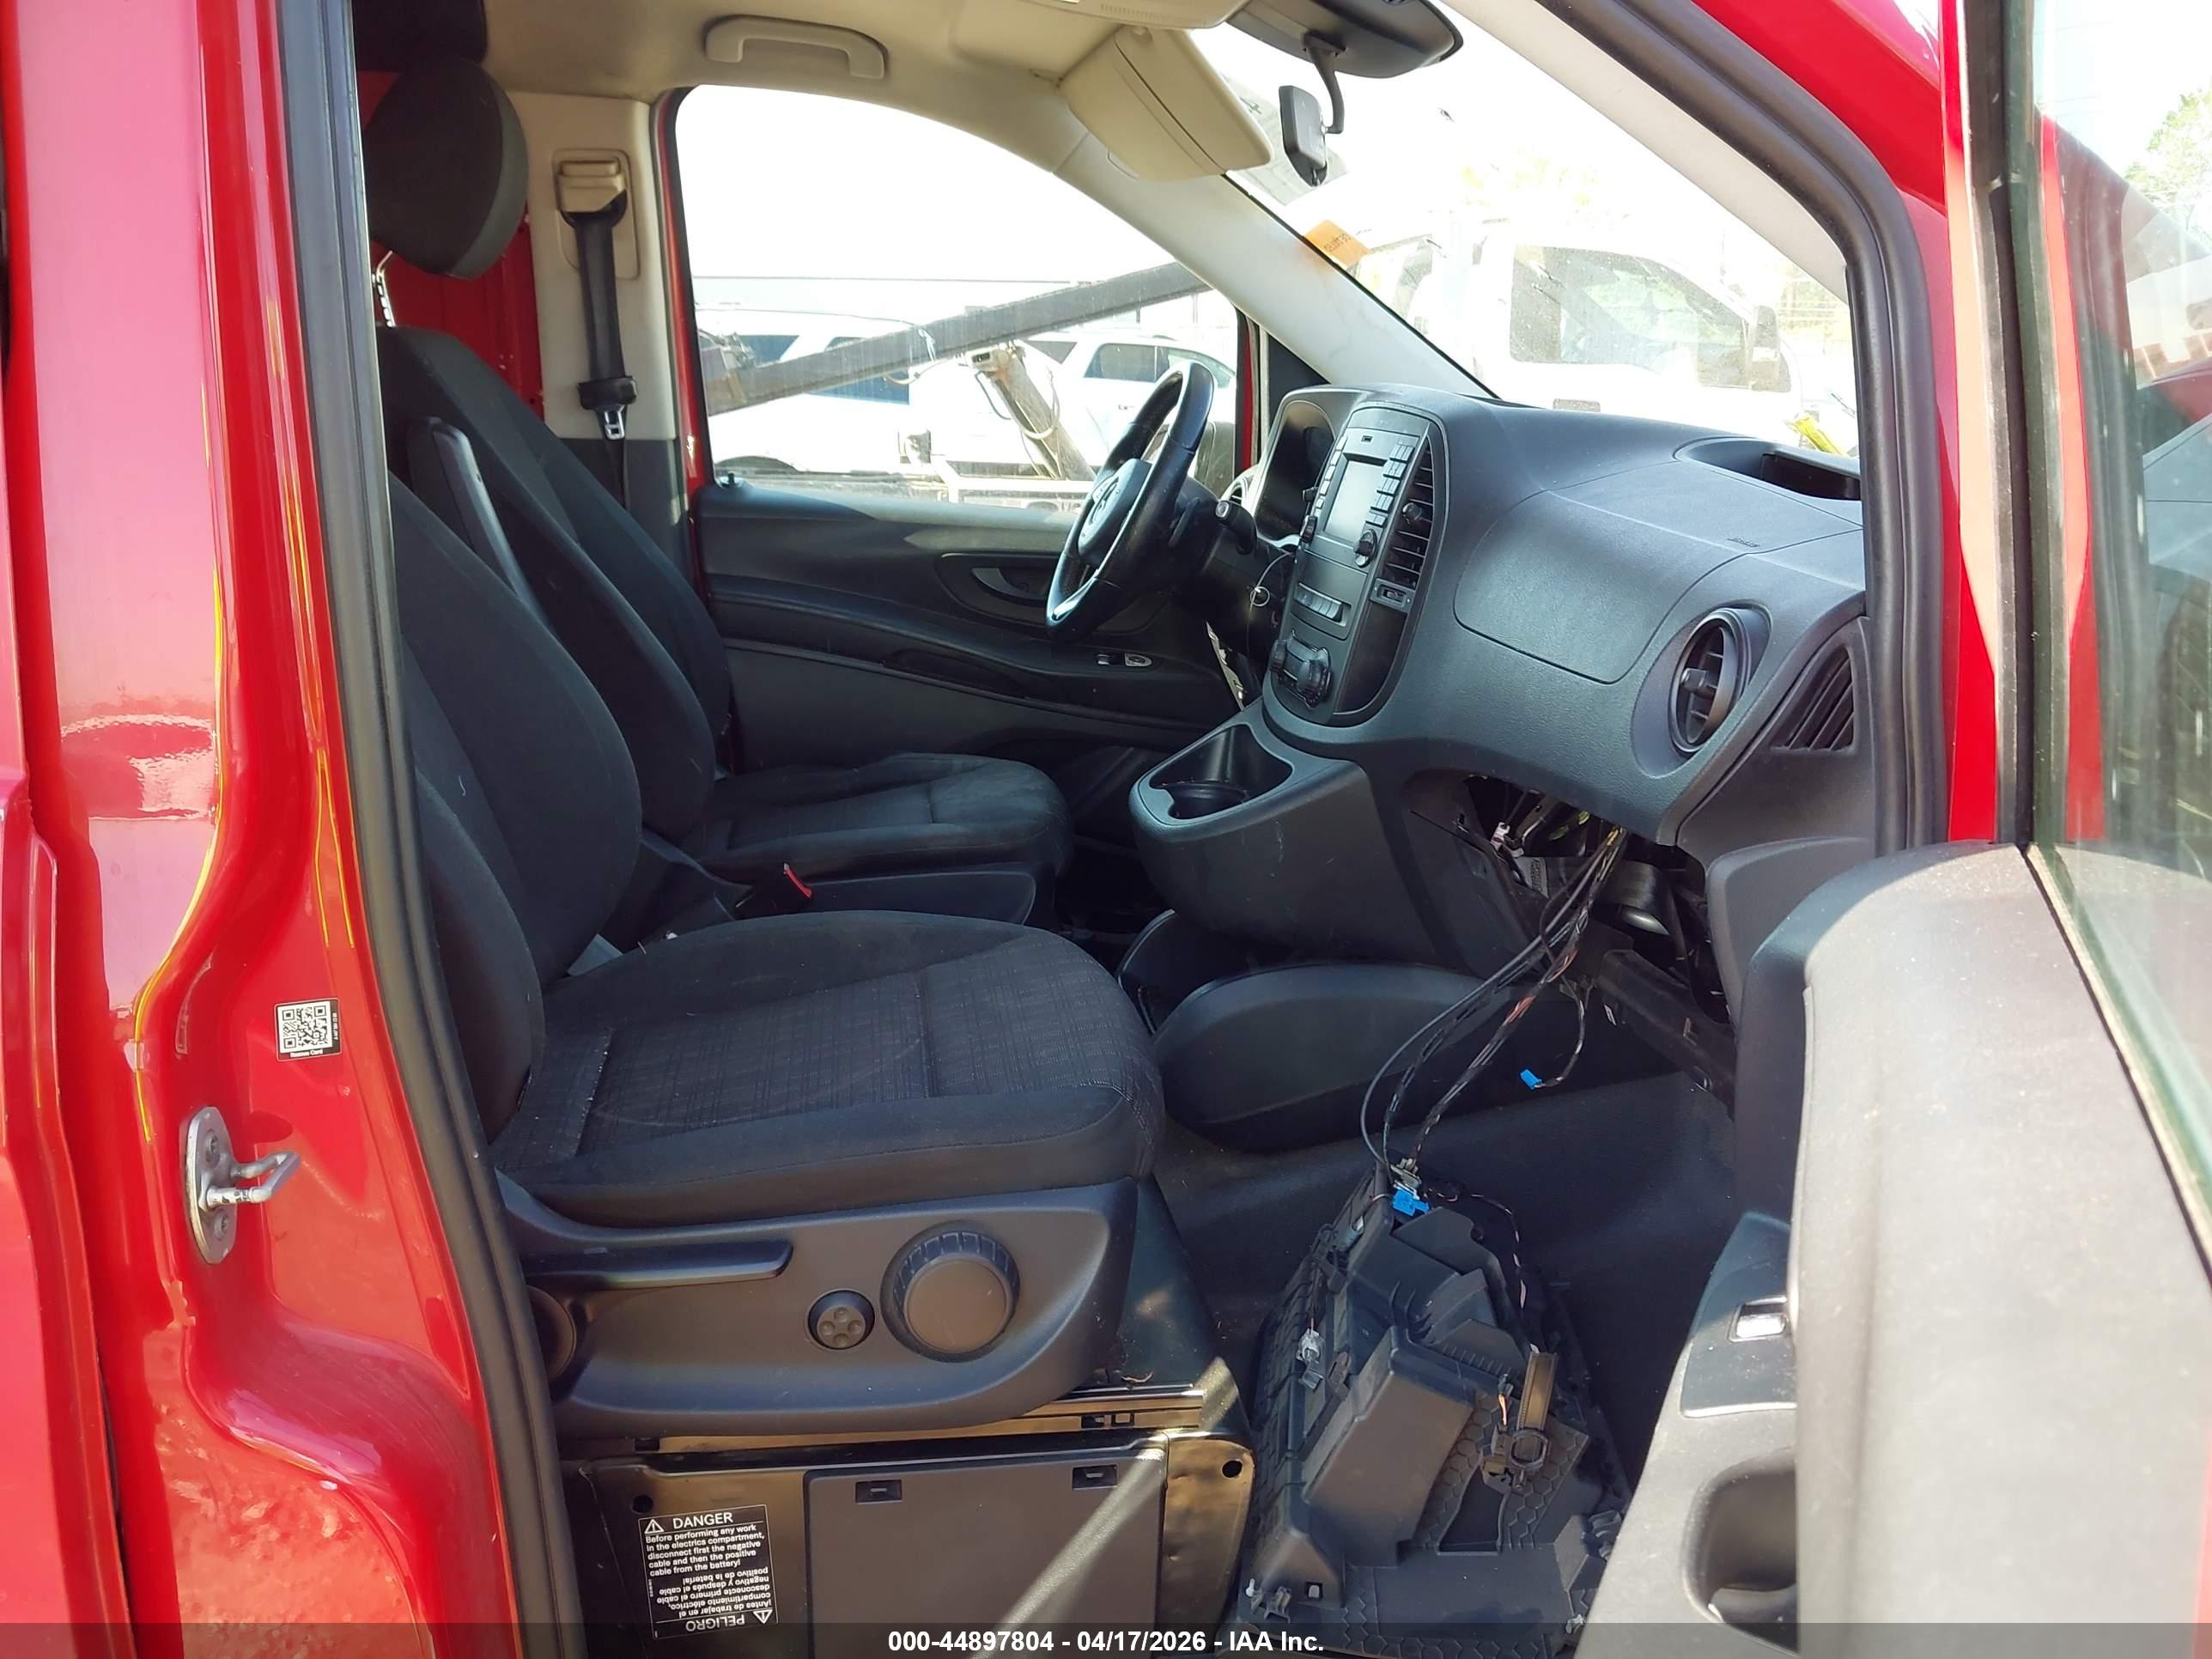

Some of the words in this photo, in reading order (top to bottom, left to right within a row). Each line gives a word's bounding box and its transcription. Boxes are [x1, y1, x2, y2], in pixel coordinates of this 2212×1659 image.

[672, 1512, 733, 1529] DANGER
[645, 1534, 672, 1544] Before
[674, 1529, 719, 1542] performing
[720, 1527, 735, 1535] any
[736, 1524, 757, 1533] work
[672, 1539, 706, 1549] electrics
[708, 1532, 764, 1545] compartment,
[647, 1548, 692, 1560] disconnect
[693, 1546, 710, 1554] first
[726, 1540, 761, 1551] negative
[648, 1559, 671, 1568] cable
[672, 1557, 688, 1565] and
[725, 1549, 757, 1560] positive
[649, 1568, 672, 1577] cable
[709, 1559, 741, 1570] battery!
[736, 1566, 769, 1577] positivo
[692, 1582, 726, 1591] después
[734, 1576, 769, 1586] negativo
[659, 1587, 681, 1595] cable
[690, 1589, 722, 1599] primero
[723, 1584, 770, 1595] desconecte
[656, 1595, 679, 1604] cable
[707, 1592, 771, 1605] compartimiento
[701, 1605, 732, 1615] trabajar
[685, 1614, 744, 1632] PELIGRO
